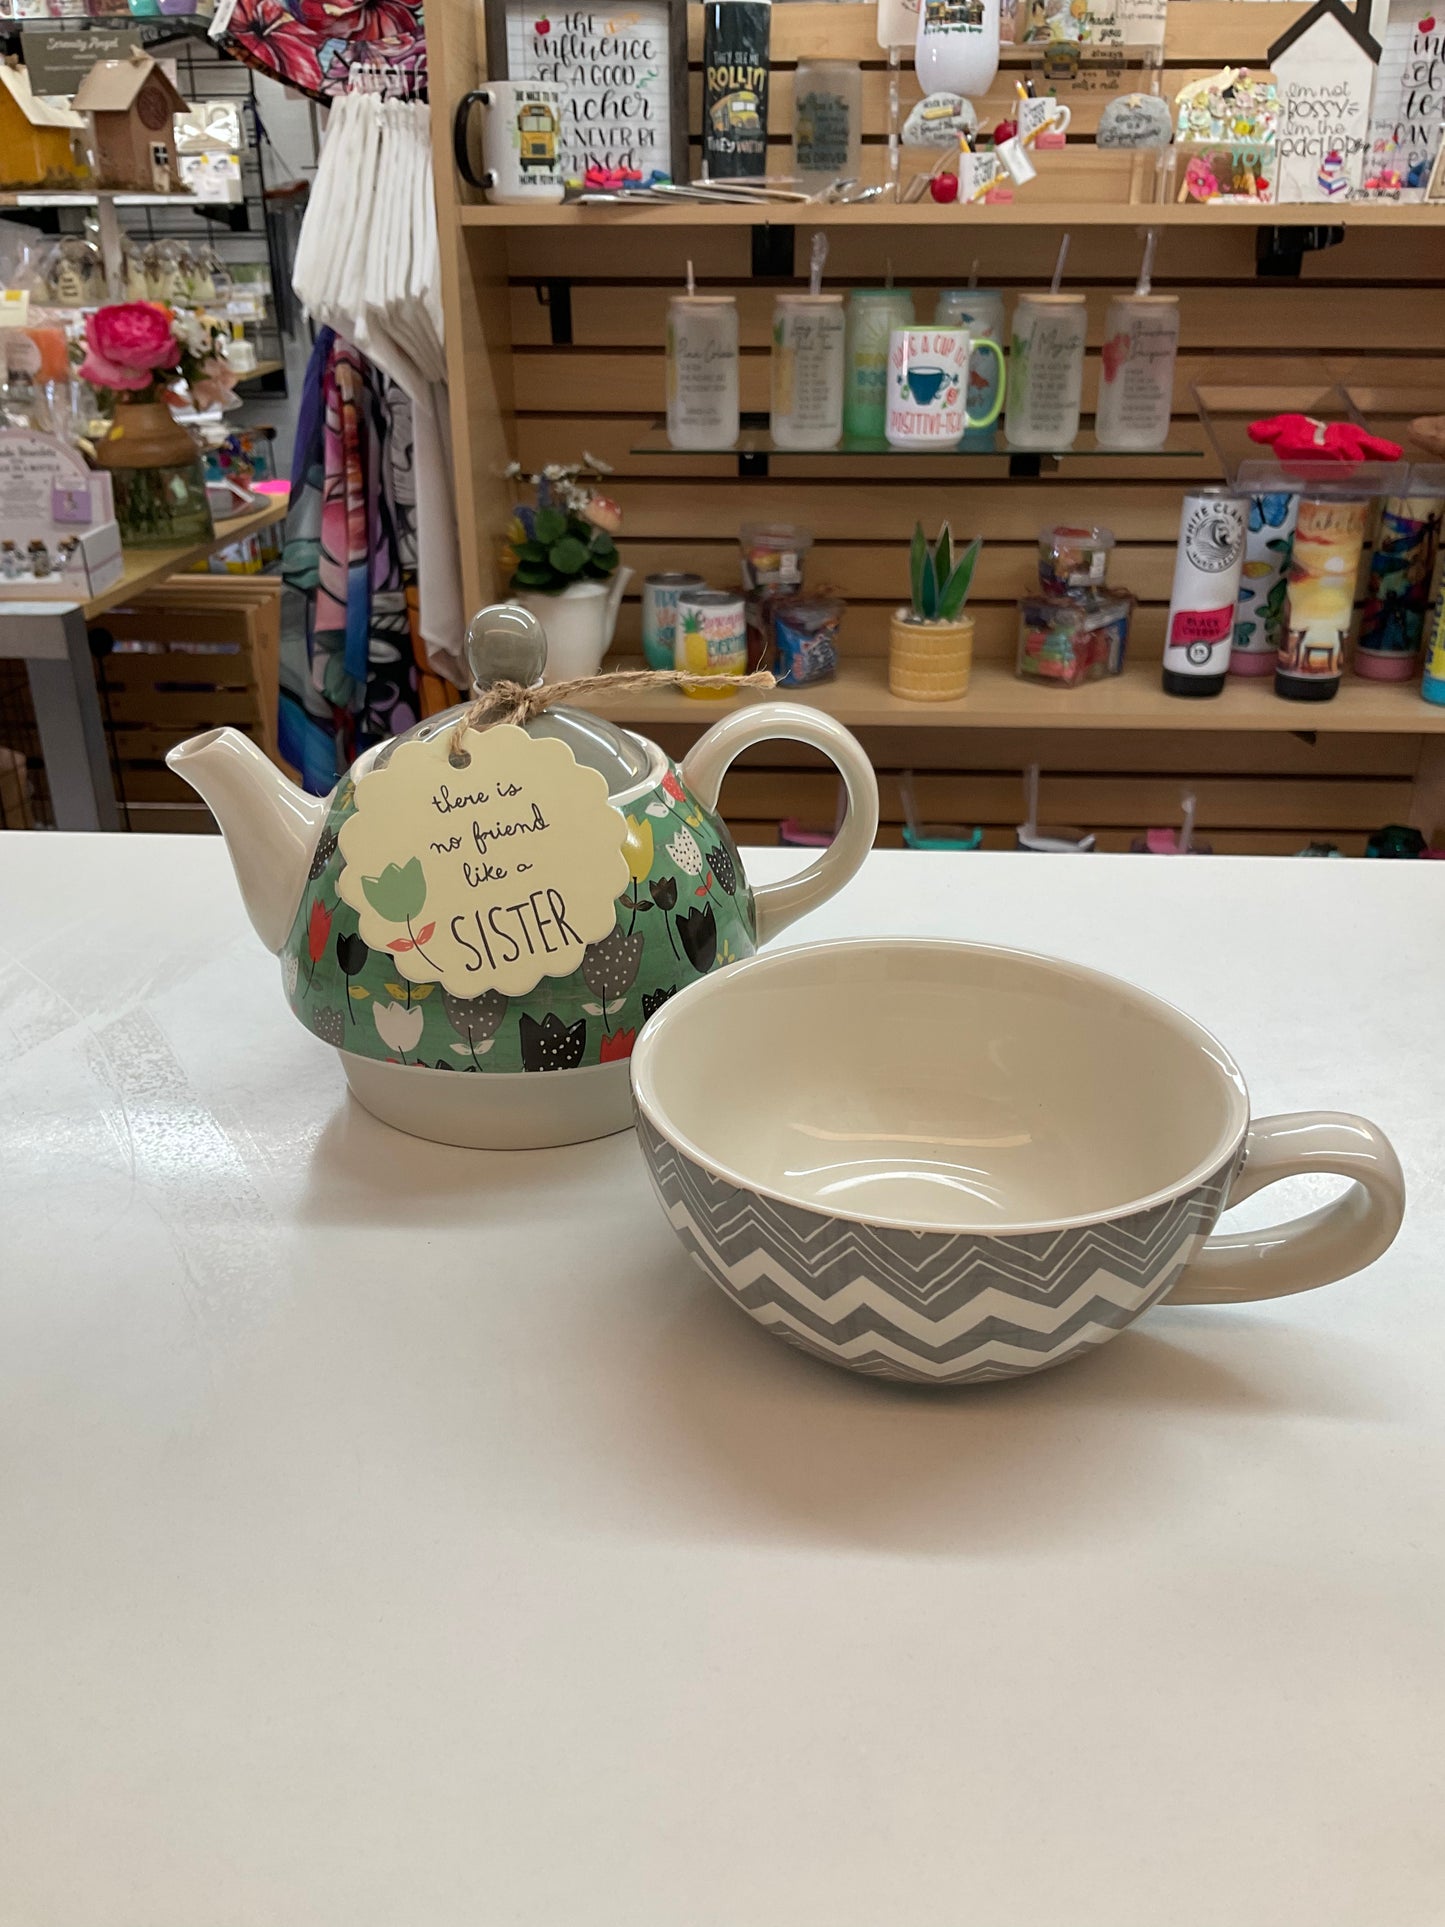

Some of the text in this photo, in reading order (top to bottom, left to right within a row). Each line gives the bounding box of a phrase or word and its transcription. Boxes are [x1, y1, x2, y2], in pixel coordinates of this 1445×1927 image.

[557, 11, 596, 37] the
[1099, 29, 1121, 41] you
[533, 33, 656, 67] influence
[570, 65, 586, 87] A
[591, 65, 636, 87] GOOD
[574, 126, 633, 147] NEVER
[637, 126, 656, 147] BE
[1231, 145, 1275, 167] YOU
[921, 335, 930, 353] A
[933, 333, 956, 357] CUP
[1186, 505, 1209, 547] WHITE
[432, 782, 523, 813] there is
[430, 803, 550, 854] no friend
[463, 862, 533, 888] like a
[451, 889, 584, 972] SISTER
